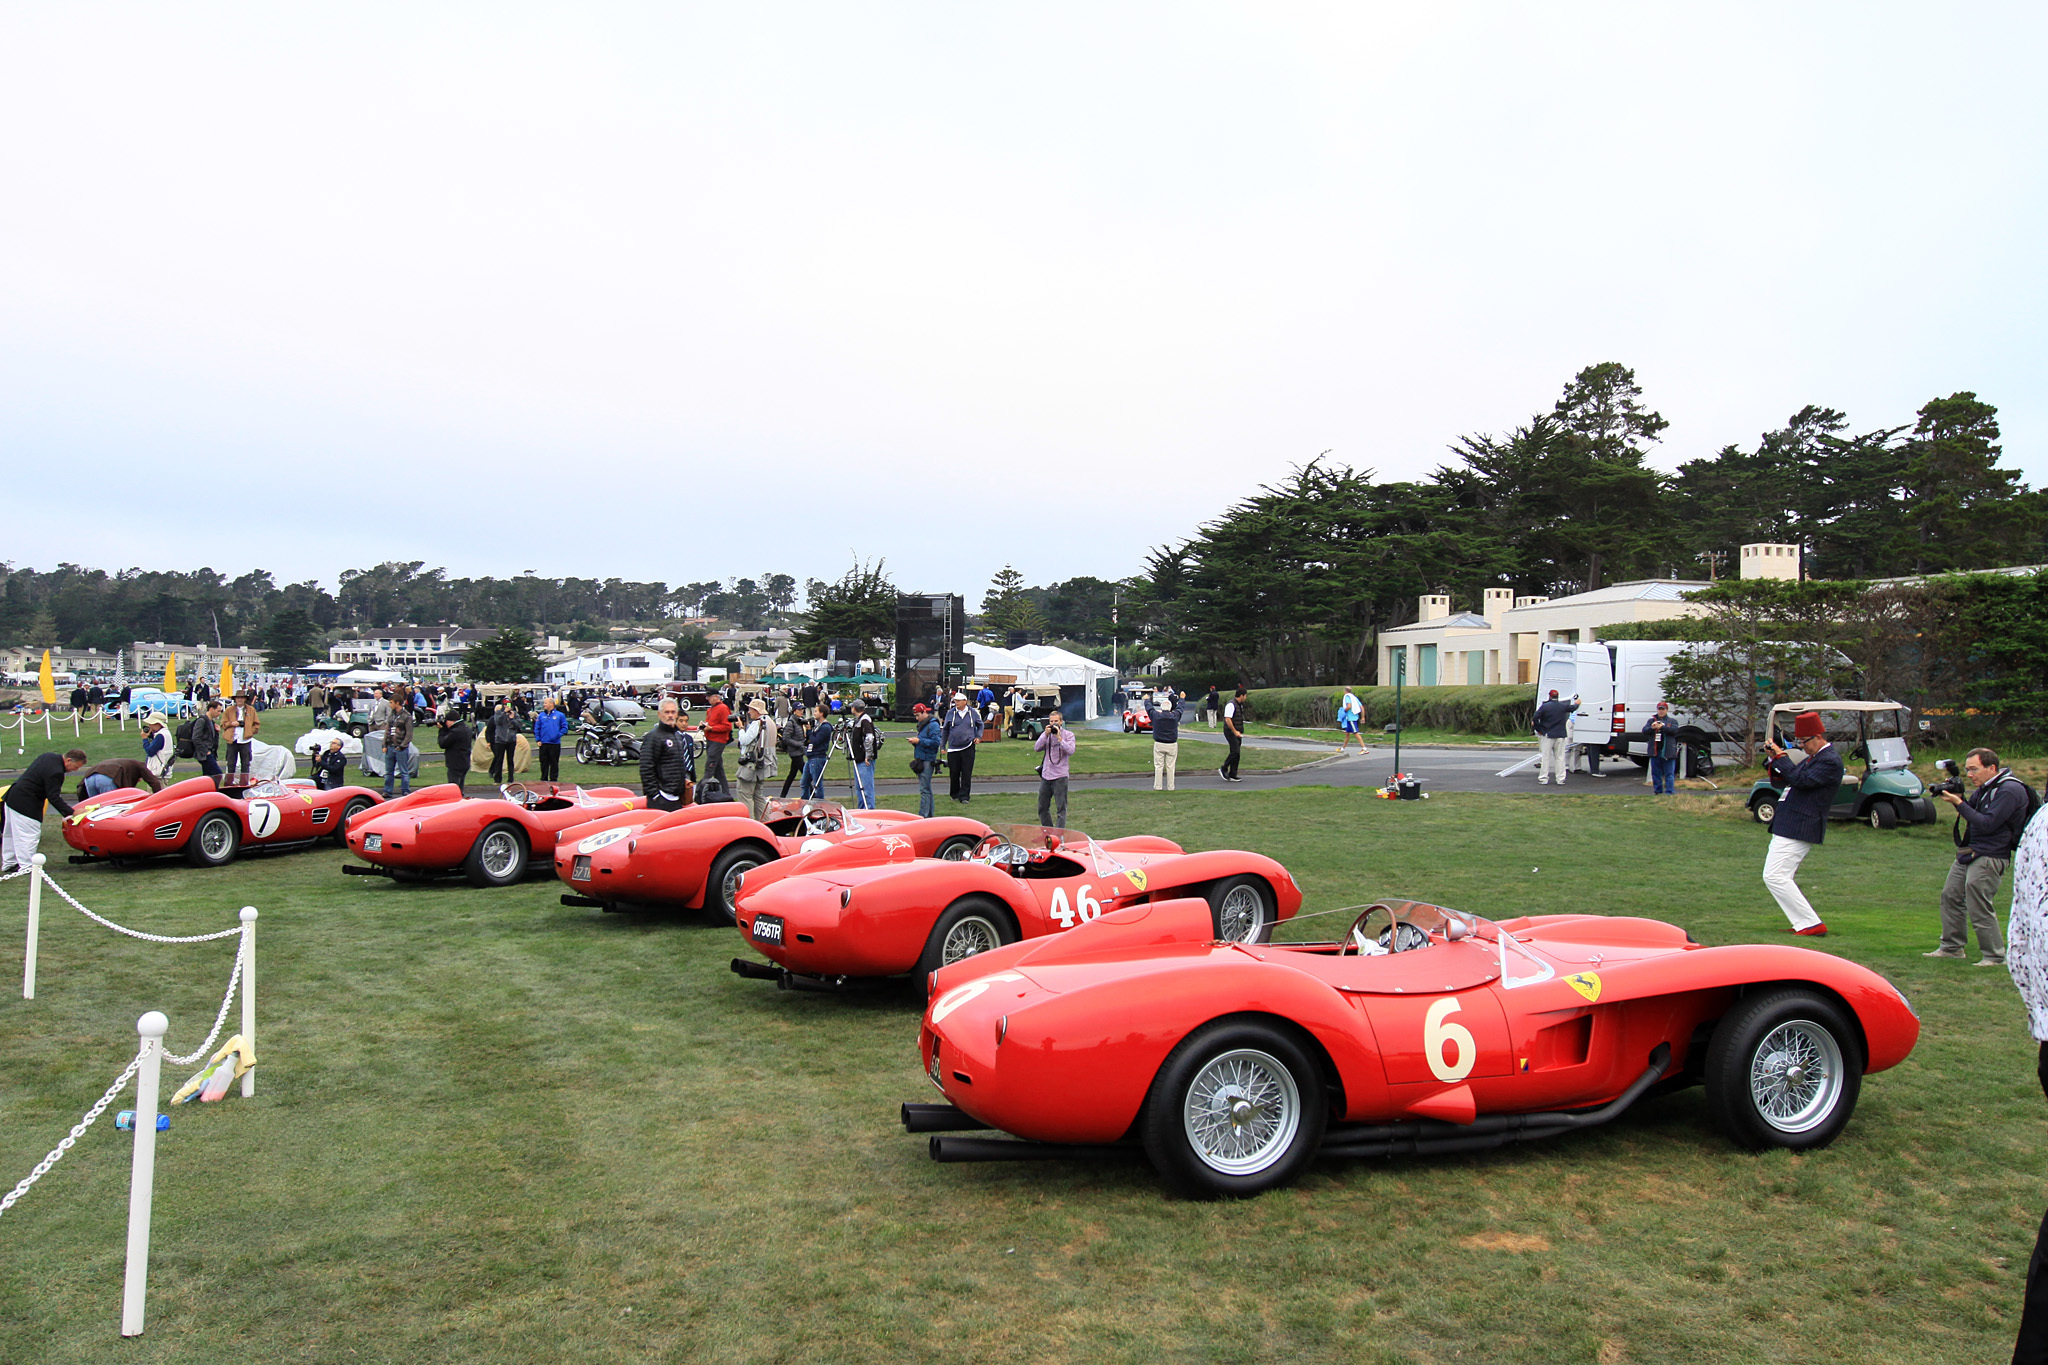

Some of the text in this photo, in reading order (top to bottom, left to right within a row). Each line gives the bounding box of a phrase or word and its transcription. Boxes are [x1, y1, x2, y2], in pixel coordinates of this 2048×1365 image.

[254, 803, 270, 836] 7
[1050, 884, 1102, 928] 46
[753, 921, 781, 940] 0756TR
[932, 974, 1025, 1024] 6
[1424, 997, 1477, 1084] 6
